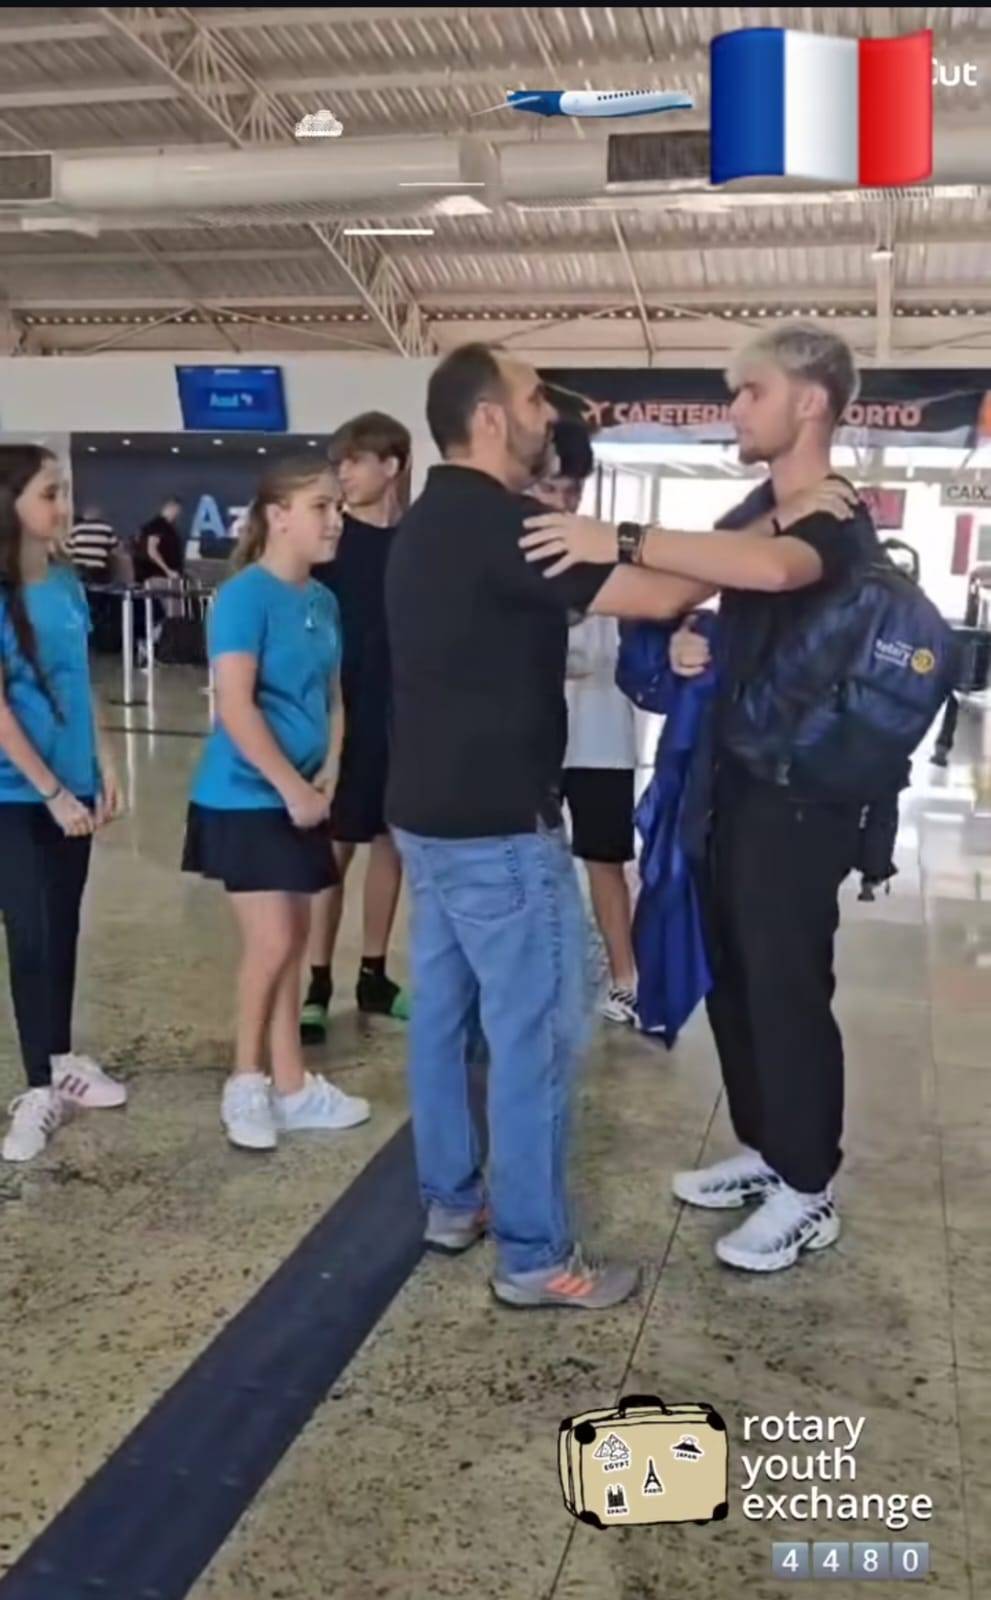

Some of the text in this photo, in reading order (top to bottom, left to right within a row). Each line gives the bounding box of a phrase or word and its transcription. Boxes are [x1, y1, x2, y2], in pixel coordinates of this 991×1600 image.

[613, 403, 921, 427] CAFETERI ORTO
[947, 485, 991, 500] CAIX
[191, 494, 249, 538] Az
